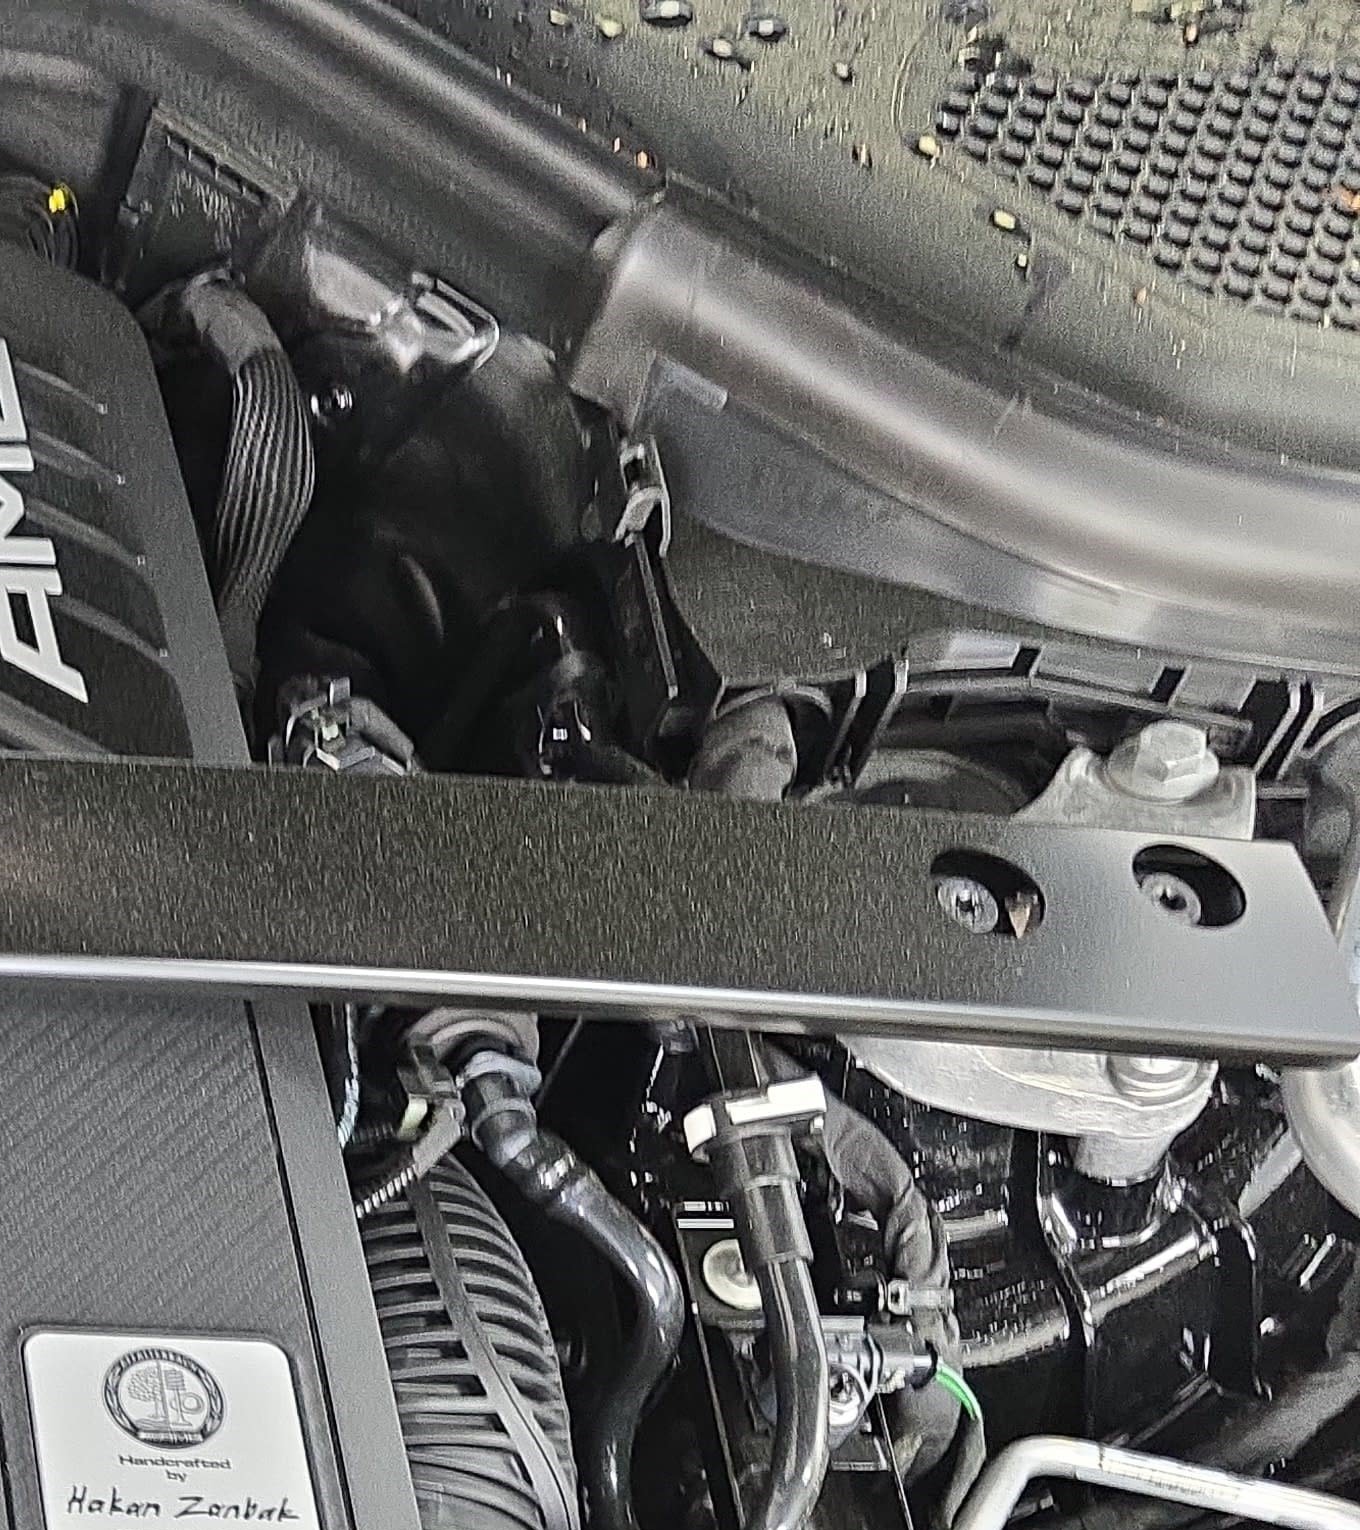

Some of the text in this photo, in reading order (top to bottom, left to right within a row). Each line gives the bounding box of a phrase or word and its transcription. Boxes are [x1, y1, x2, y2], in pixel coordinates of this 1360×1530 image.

[119, 1454, 232, 1470] Handcrafted
[165, 1469, 187, 1483] by
[66, 1484, 161, 1518] Hakan
